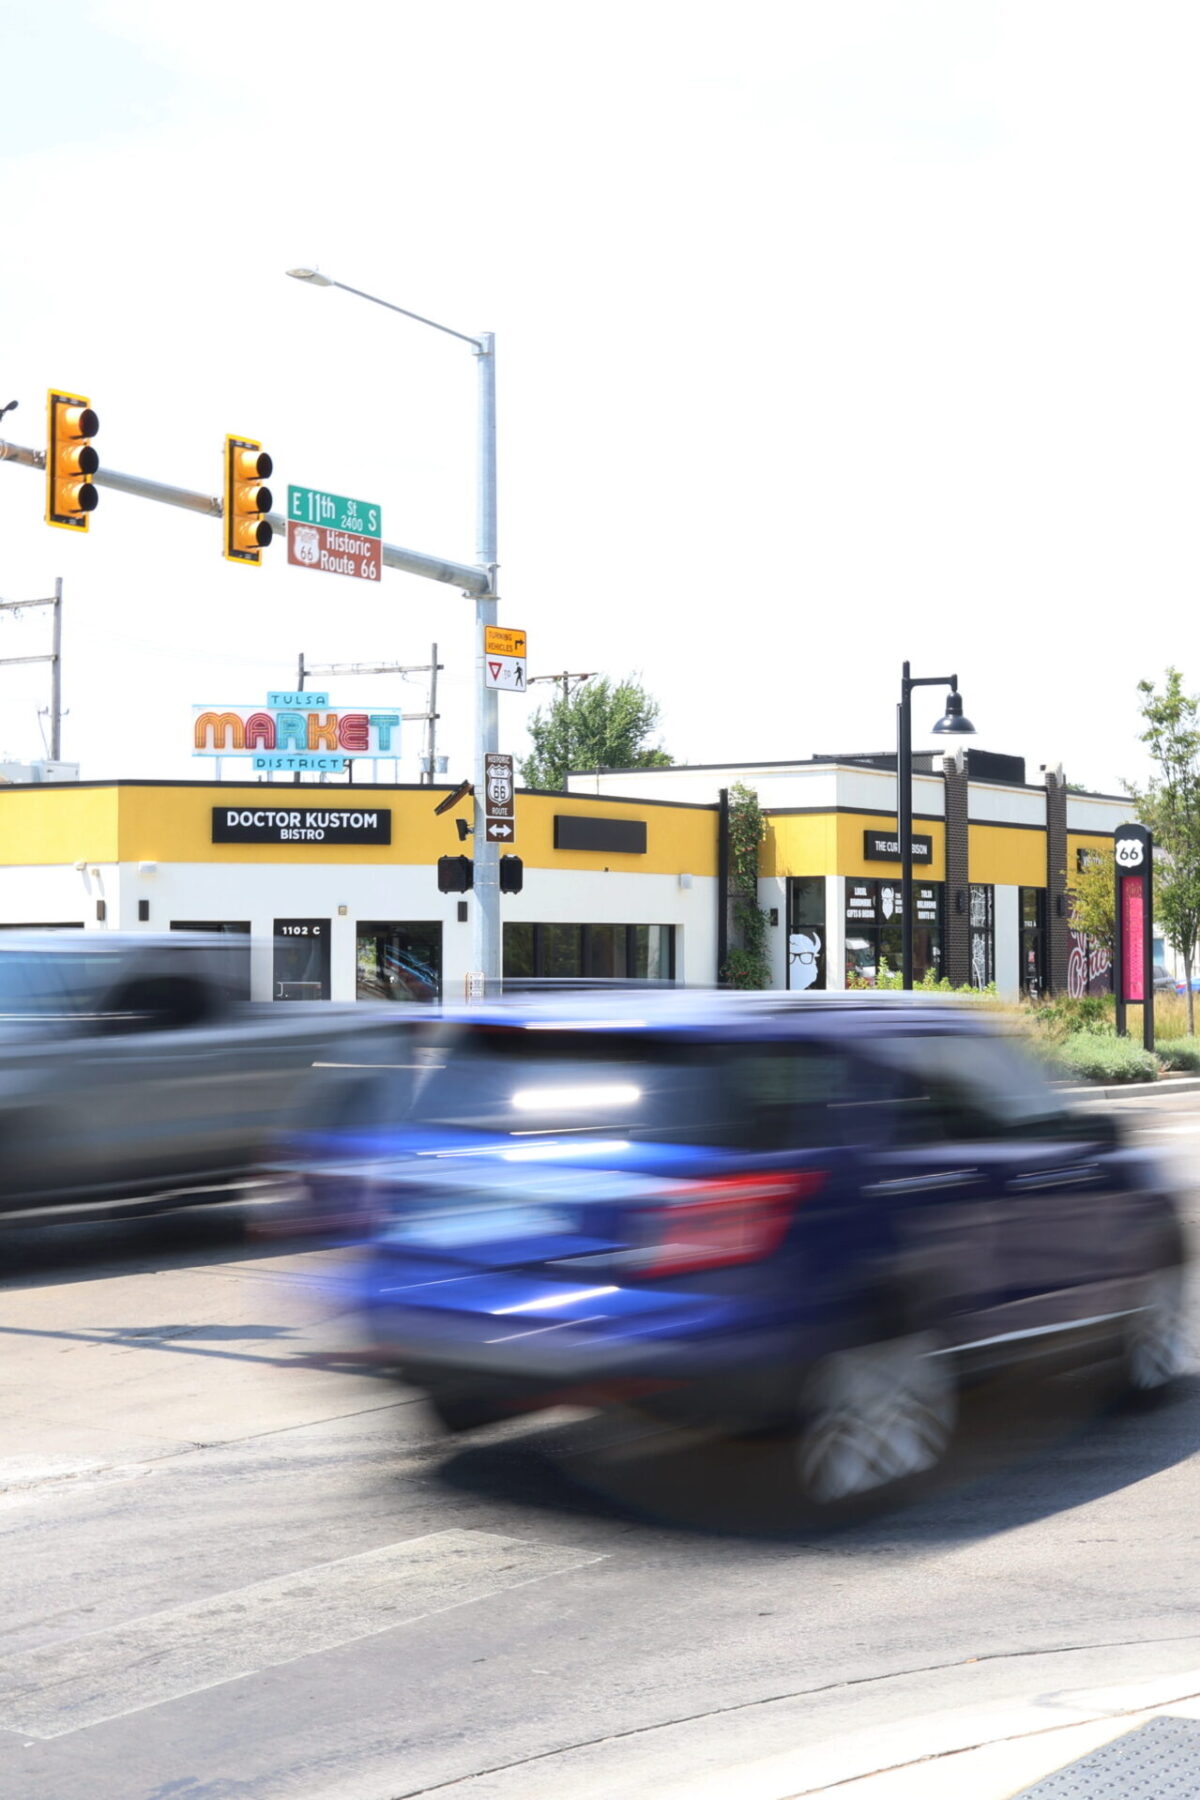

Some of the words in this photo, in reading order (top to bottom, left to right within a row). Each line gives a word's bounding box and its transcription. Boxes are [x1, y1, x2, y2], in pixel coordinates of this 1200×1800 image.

[293, 492, 302, 515] E
[308, 492, 336, 522] 11th
[347, 501, 357, 516] St
[341, 515, 363, 531] 2400
[368, 509, 377, 531] S
[326, 530, 371, 557] Historic
[300, 546, 313, 561] 66
[320, 550, 355, 575] Route
[361, 559, 376, 579] 66
[271, 694, 326, 705] TULSA
[195, 712, 400, 751] MARKET
[256, 758, 339, 769] DISTRICT
[493, 785, 506, 799] 66
[491, 807, 508, 816] ROUTE
[226, 811, 301, 827] DOCTOR
[306, 813, 378, 829] KUSTOM
[280, 829, 325, 840] BISTRO
[875, 840, 886, 852] THE
[1120, 842, 1139, 861] 66
[282, 926, 309, 935] 1102
[312, 926, 321, 935] C
